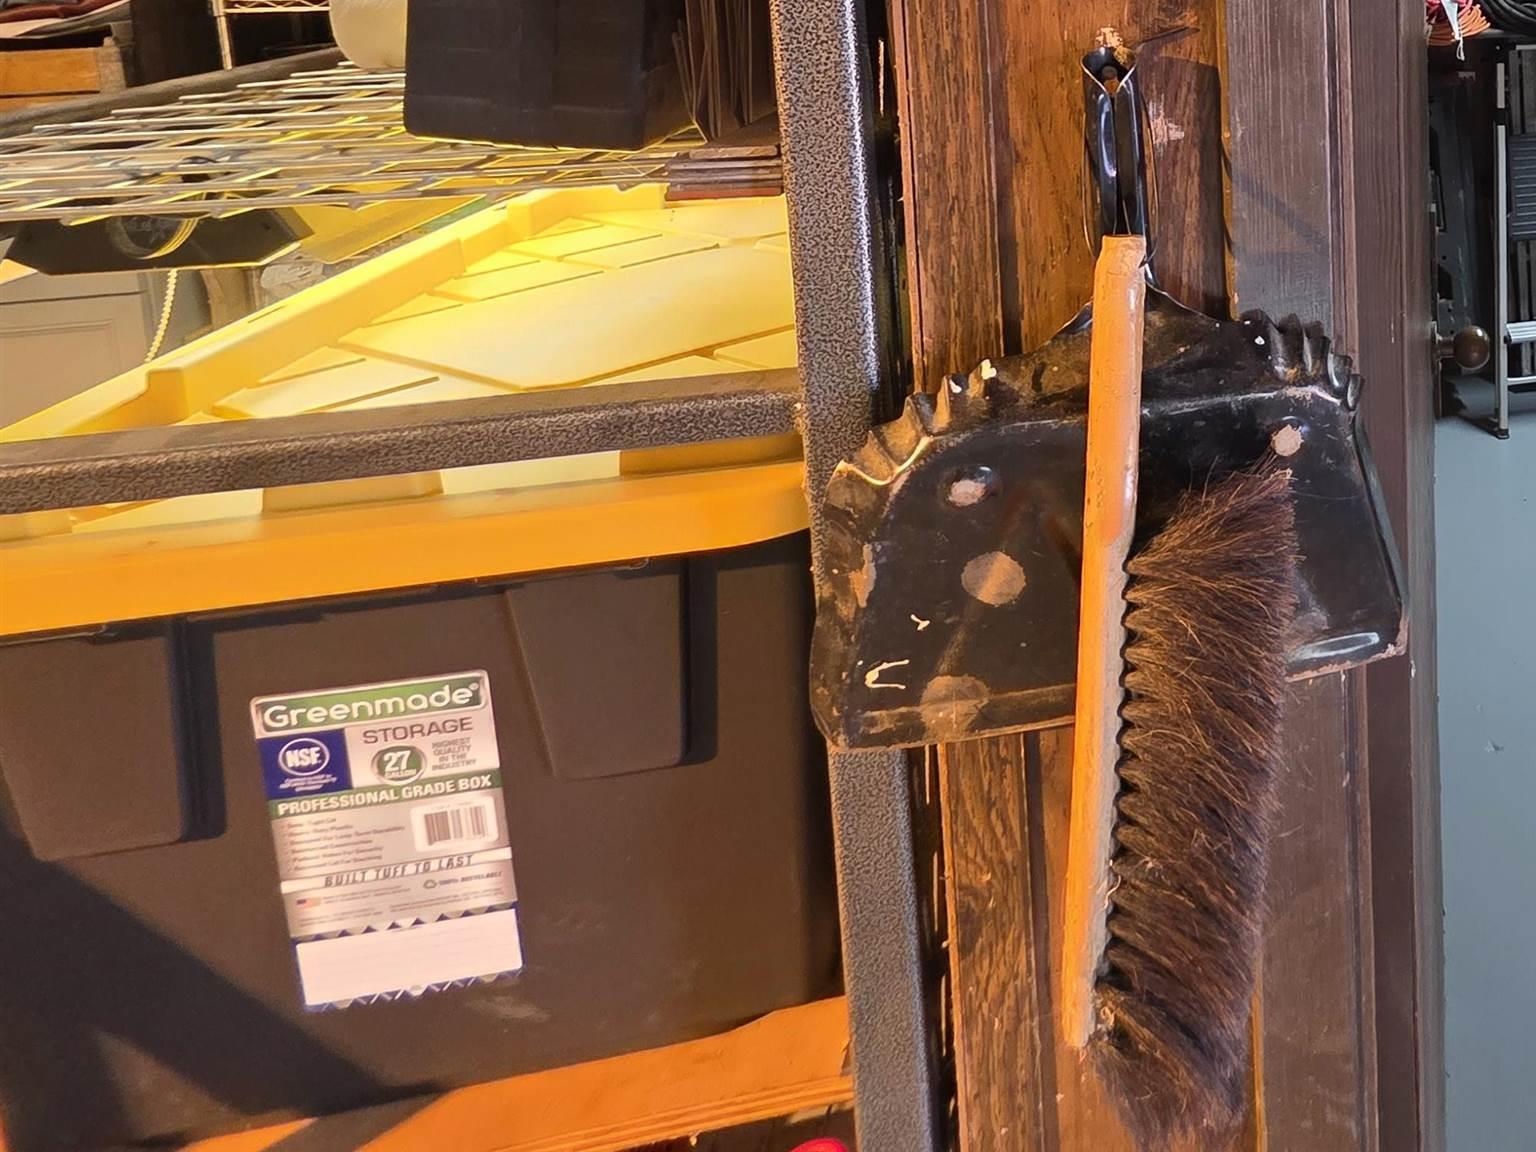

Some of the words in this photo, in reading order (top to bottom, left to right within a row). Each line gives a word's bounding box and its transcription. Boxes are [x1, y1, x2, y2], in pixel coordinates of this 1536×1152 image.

[263, 684, 473, 728] Greenmade
[363, 717, 473, 744] STORAGE
[432, 737, 471, 749] HIGHEST
[433, 745, 471, 756] QUALITY
[285, 747, 321, 768] NSF
[383, 750, 412, 773] 27
[452, 753, 467, 761] THE
[278, 787, 399, 816] PROFESSIONAL
[402, 780, 455, 797] GRADE
[458, 774, 492, 792] BOX
[324, 870, 367, 887] BUILT
[375, 865, 407, 879] TUFF
[415, 862, 431, 874] TO
[438, 854, 474, 870] LAST
